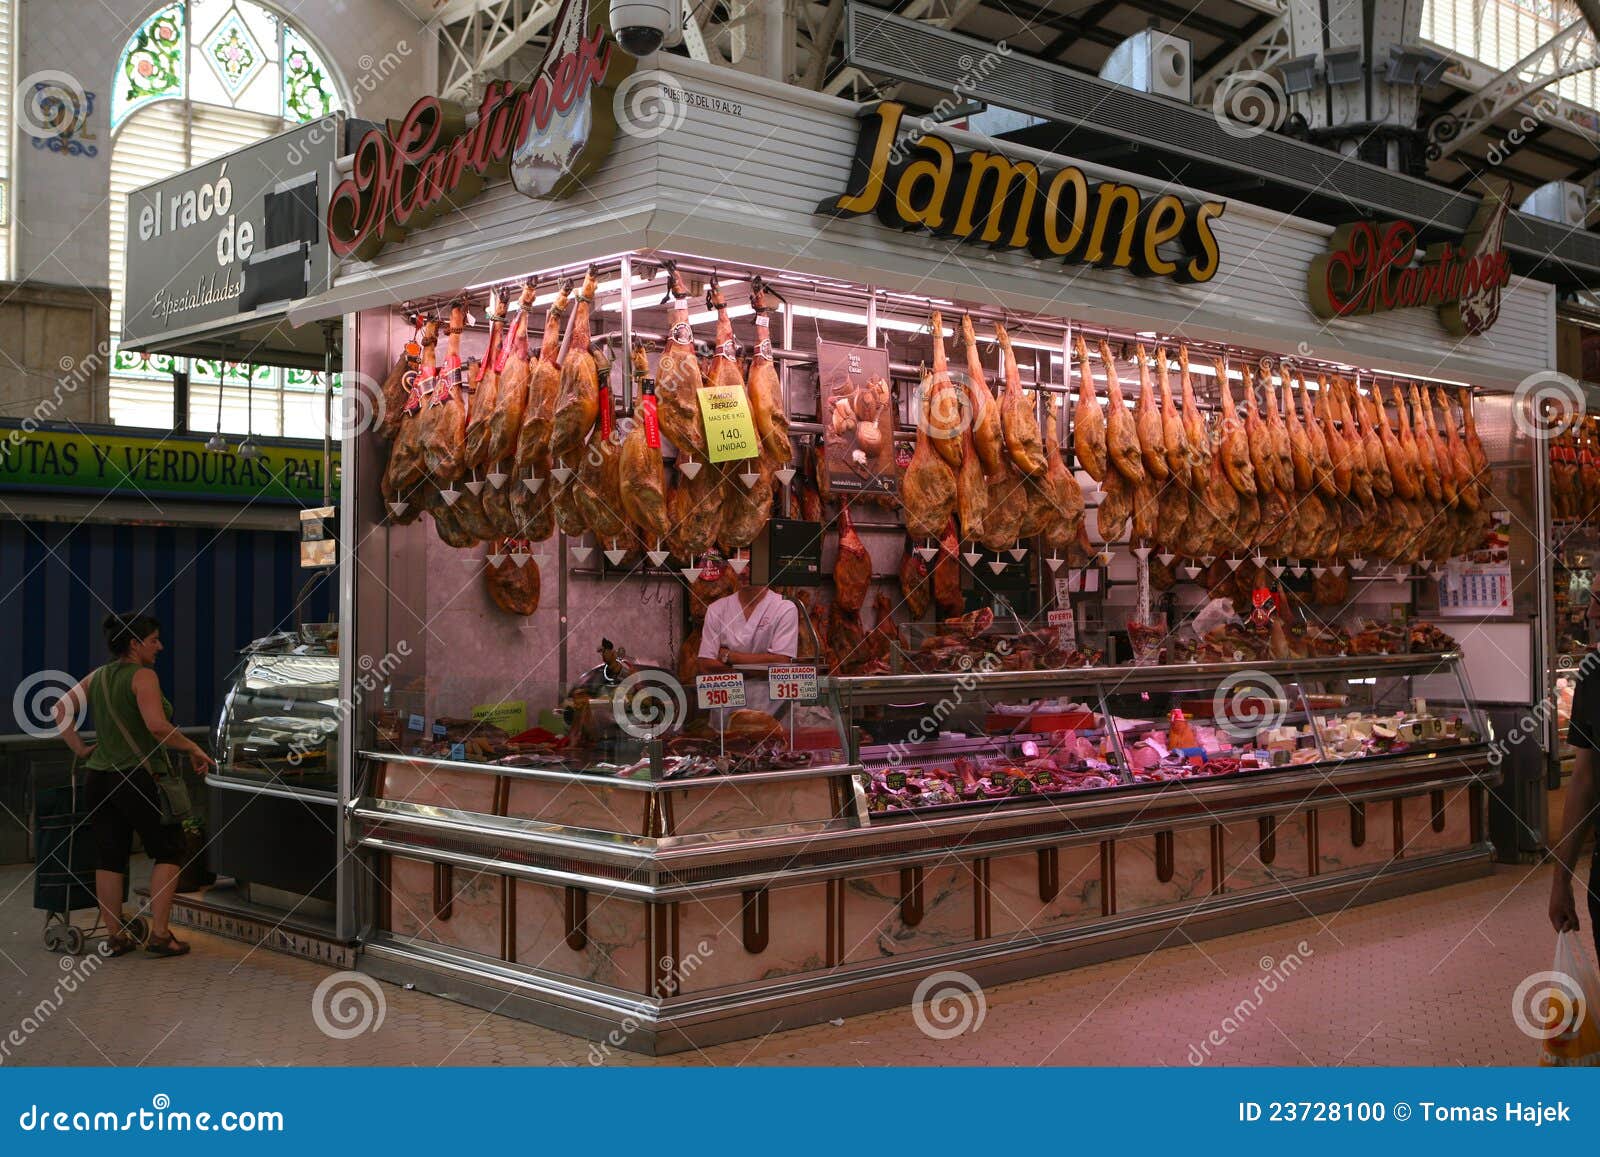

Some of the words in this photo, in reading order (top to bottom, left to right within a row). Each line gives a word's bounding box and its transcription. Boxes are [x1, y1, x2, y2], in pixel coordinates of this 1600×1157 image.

[663, 87, 695, 104] PUESTOS
[695, 95, 710, 108] DEL
[711, 98, 721, 109] 19
[722, 102, 732, 113] AL
[732, 104, 743, 116] 22
[139, 191, 162, 241] el
[170, 162, 232, 231] racó
[832, 101, 1227, 283] Jamones
[217, 214, 254, 266] de
[151, 266, 242, 328] Especialidades
[710, 401, 739, 410] IBERICO
[716, 441, 747, 452] UNIDAD
[0, 439, 79, 477] UTAS
[91, 444, 111, 478] Y
[124, 447, 271, 489] VERDURAS
[702, 673, 738, 683] JAMON
[771, 666, 790, 674] JAMON
[790, 665, 815, 673] ARAGON
[699, 680, 743, 689] ARAGON
[777, 683, 799, 699] 315
